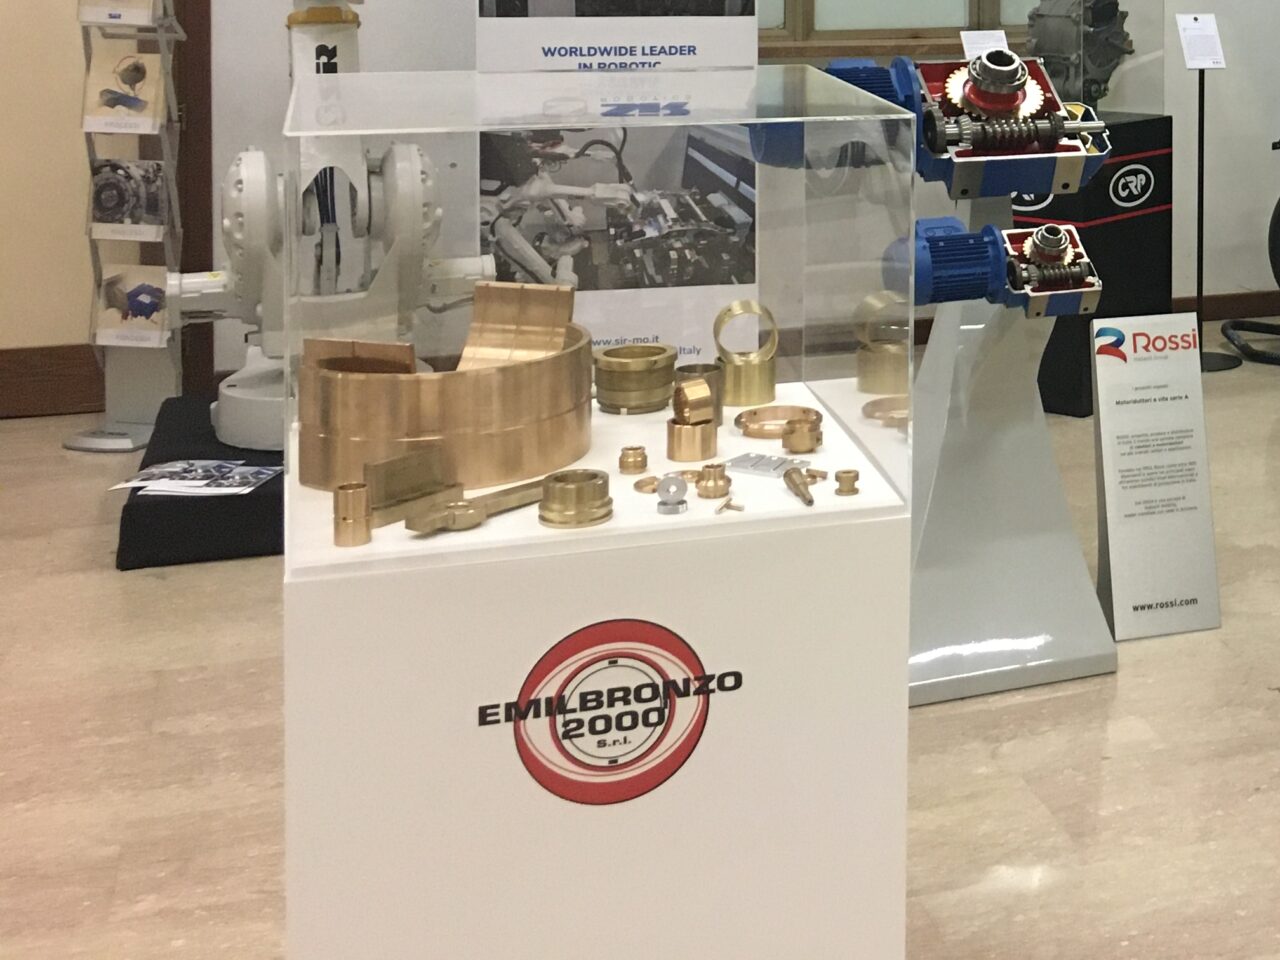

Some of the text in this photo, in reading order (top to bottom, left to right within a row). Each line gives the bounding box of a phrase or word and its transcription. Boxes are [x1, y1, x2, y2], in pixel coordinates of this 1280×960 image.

[542, 45, 697, 57] WORLDWIDE LEADER
[1118, 173, 1146, 198] CRP
[592, 335, 660, 346] ww.sir-mo.it
[680, 345, 702, 356] Italy
[1132, 328, 1198, 354] Rossi
[1132, 597, 1198, 612] www.rossi.com
[478, 671, 743, 727] EMILBRONZO
[561, 706, 666, 741] 2000
